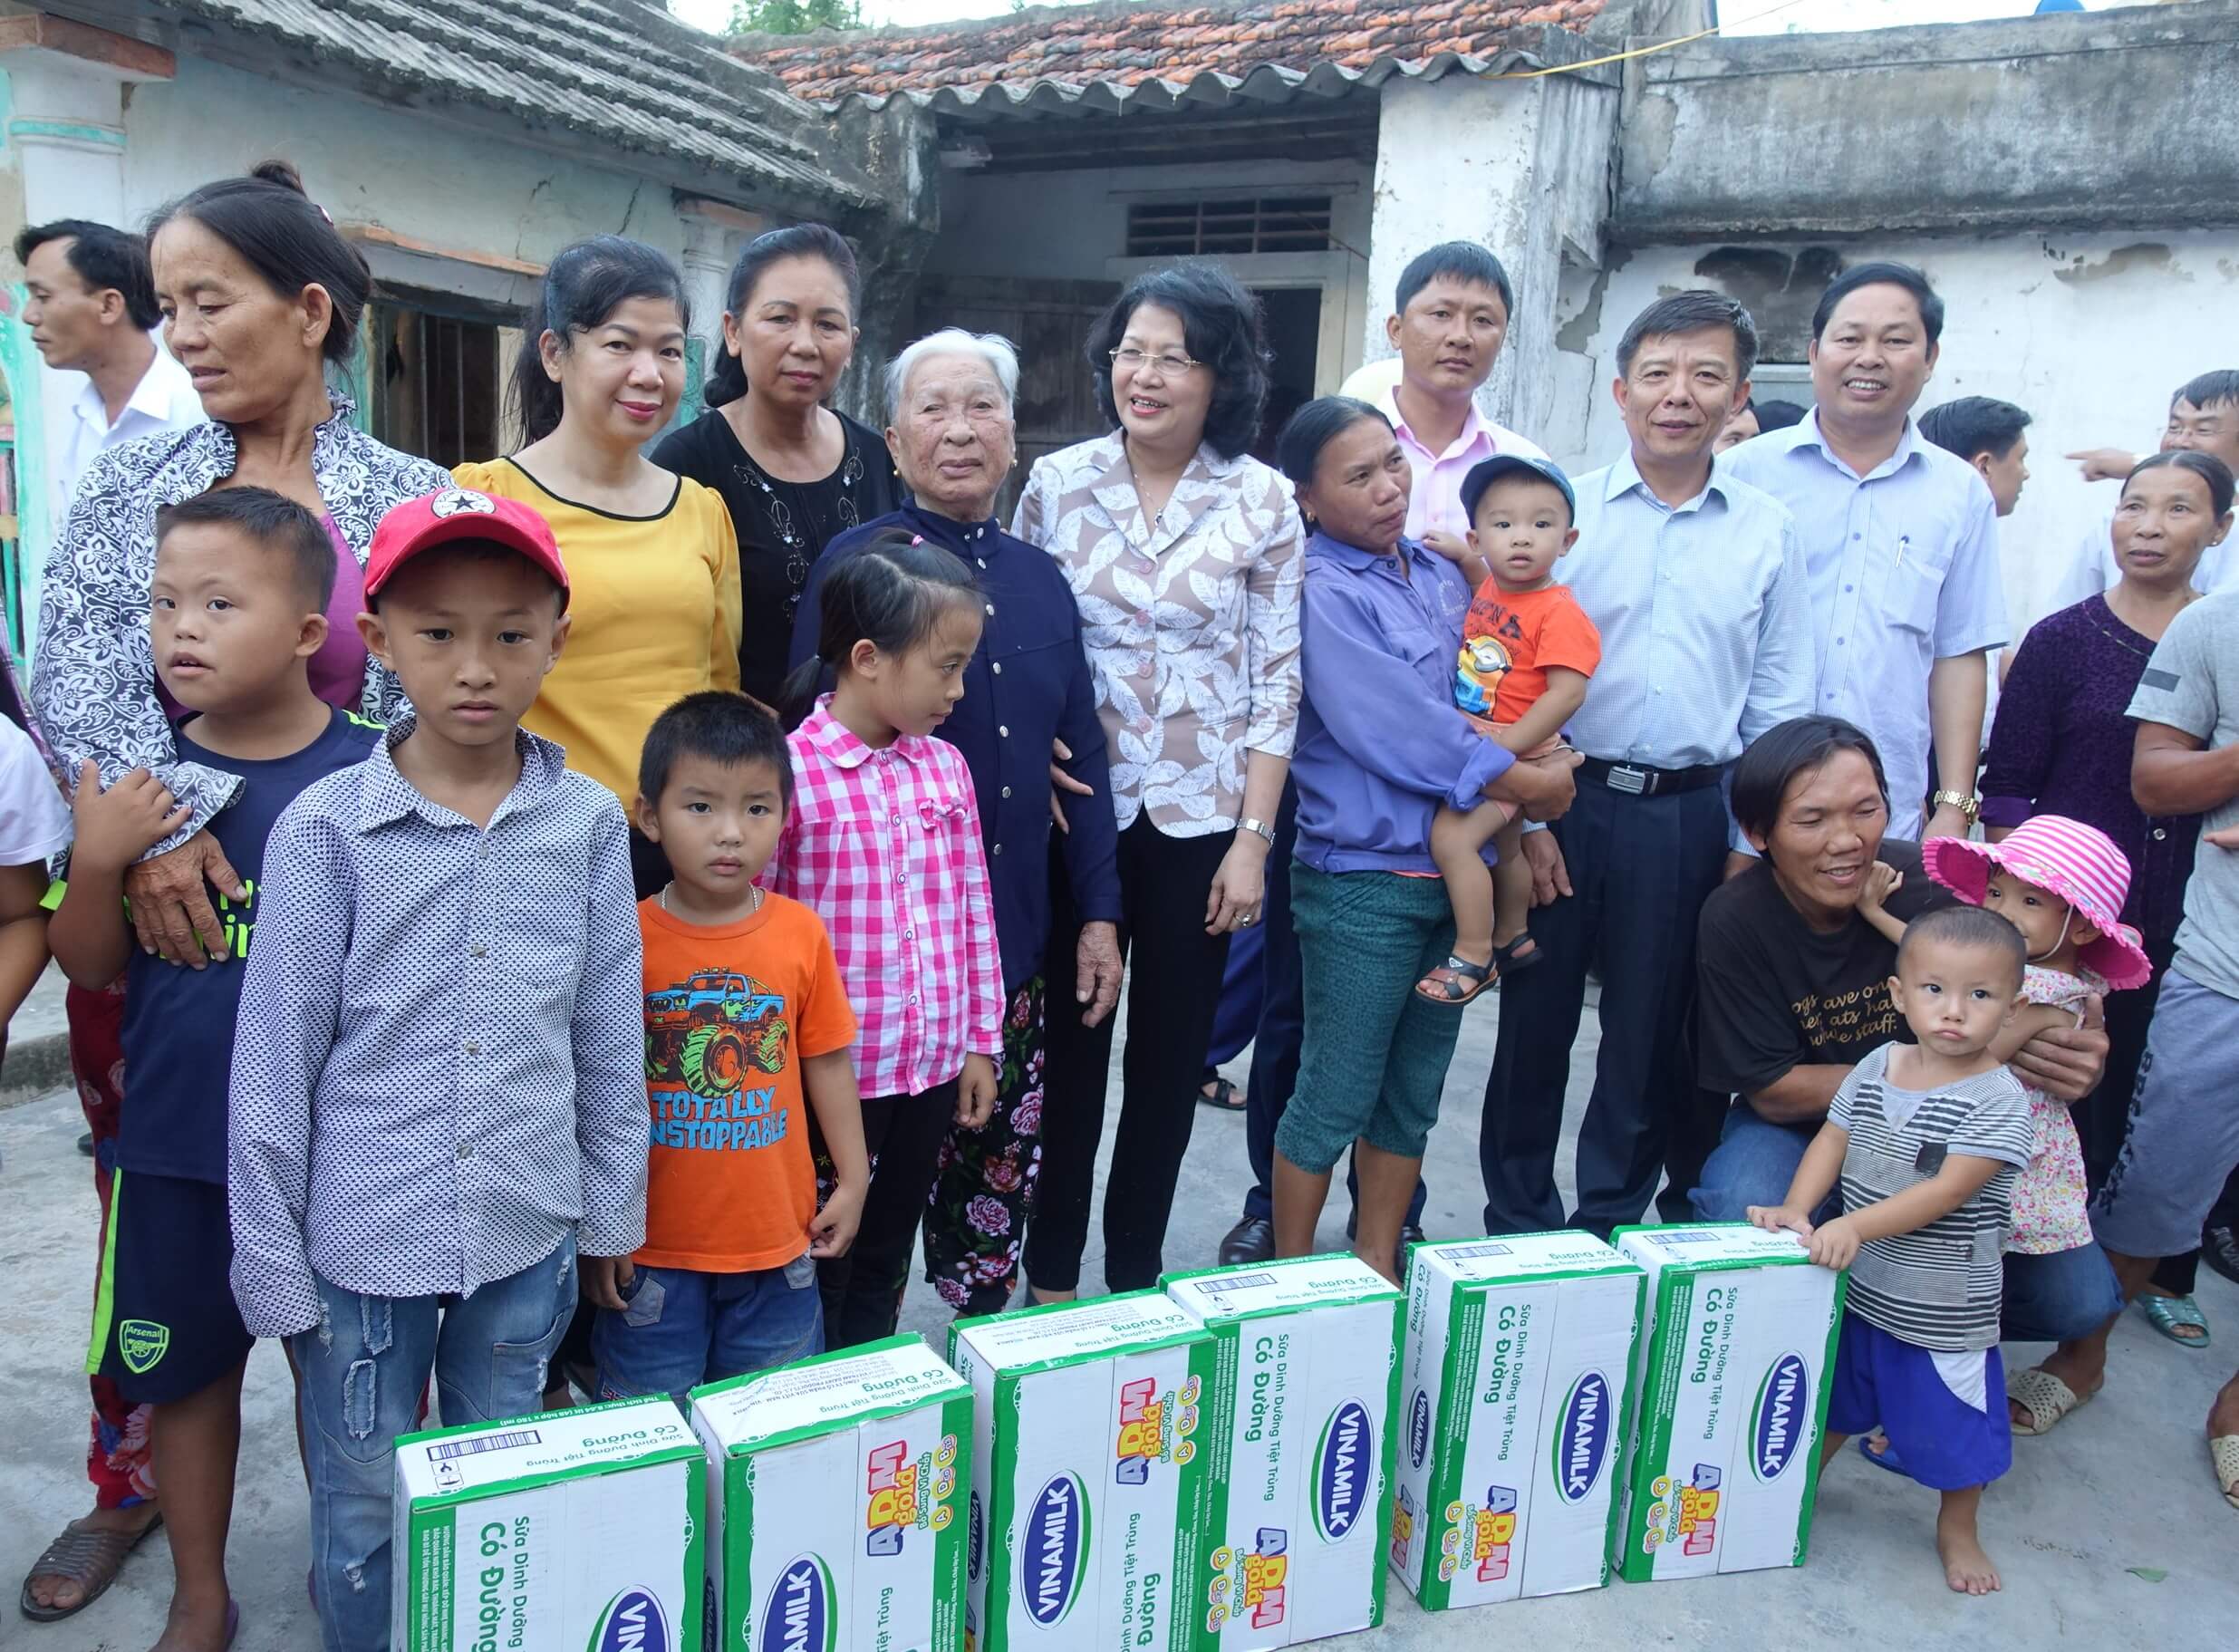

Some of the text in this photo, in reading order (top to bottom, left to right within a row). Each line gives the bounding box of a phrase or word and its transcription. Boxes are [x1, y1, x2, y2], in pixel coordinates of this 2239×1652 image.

[650, 1109, 787, 1151] NSTOPPABLE
[652, 1087, 776, 1119] TOTALLY
[128, 1326, 160, 1338] Arsenal
[1110, 1314, 1184, 1331] Có Đường
[1483, 1306, 1515, 1403] Có Đường
[1690, 1288, 1722, 1383] Có Đường
[1703, 1287, 1737, 1439] Sữa Dinh Dưỡng Tiệt Trùng
[861, 1369, 943, 1392] Có Đường
[1244, 1337, 1272, 1442] Có Đường
[1263, 1333, 1288, 1501] Sữa Dinh Dưỡng Tiệt Trùng
[1497, 1304, 1530, 1461] Sữa Dinh Dưỡng Tiệt Trùng
[1760, 1362, 1799, 1473] VINAMILK
[582, 1425, 678, 1446] Có Đường
[1113, 1377, 1155, 1487] ADM
[1137, 1400, 1164, 1459] gold
[1158, 1389, 1175, 1464] Bổ Sung Vi Chất
[1411, 1387, 1427, 1471] VINAMILK
[1566, 1379, 1600, 1495] VINAMILK
[865, 1438, 907, 1558] ADM
[893, 1463, 919, 1527] gold
[914, 1450, 931, 1530] Bổ Sung Vi Chất
[1327, 1408, 1363, 1532] VINAMILK
[1675, 1485, 1702, 1534] gold
[1682, 1461, 1725, 1557] ADM
[1037, 1481, 1071, 1616] VINAMILK
[1124, 1512, 1140, 1548] Trùng
[1124, 1553, 1137, 1577] Tiệt
[1472, 1508, 1496, 1560] gold
[1476, 1482, 1520, 1583] ADM
[470, 1522, 507, 1652] Có Đường
[507, 1516, 529, 1647] Sữa Dinh Dưỡng
[876, 1587, 893, 1627] Trùng
[1122, 1580, 1136, 1624] Dưỡng
[1136, 1572, 1161, 1646] Đường
[1242, 1551, 1266, 1608] gold
[1250, 1523, 1290, 1630] ADM
